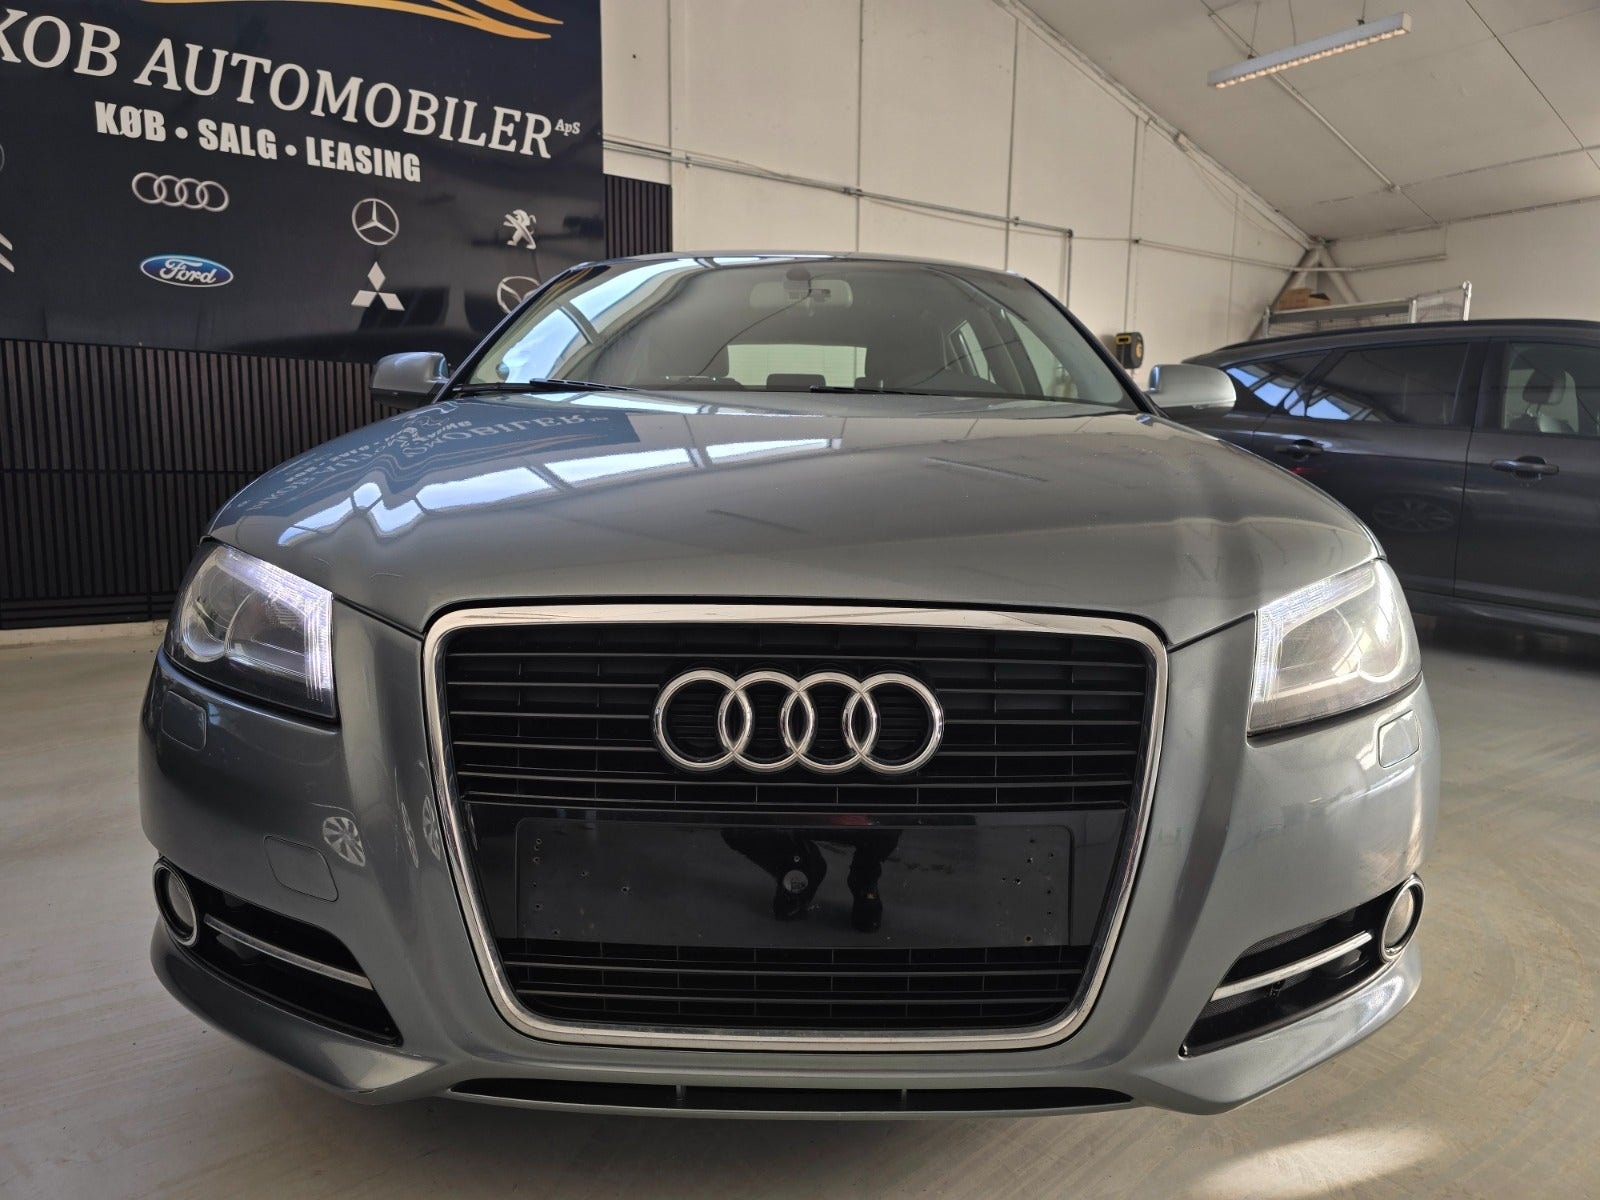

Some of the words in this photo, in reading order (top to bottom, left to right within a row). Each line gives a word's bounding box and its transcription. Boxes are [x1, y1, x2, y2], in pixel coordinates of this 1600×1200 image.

[133, 38, 552, 159] AUTOMOBILER
[554, 118, 581, 137] ApS
[95, 100, 167, 143] KØB
[198, 119, 278, 160] SALG
[305, 136, 421, 183] LEASING
[159, 258, 218, 284] Ford
